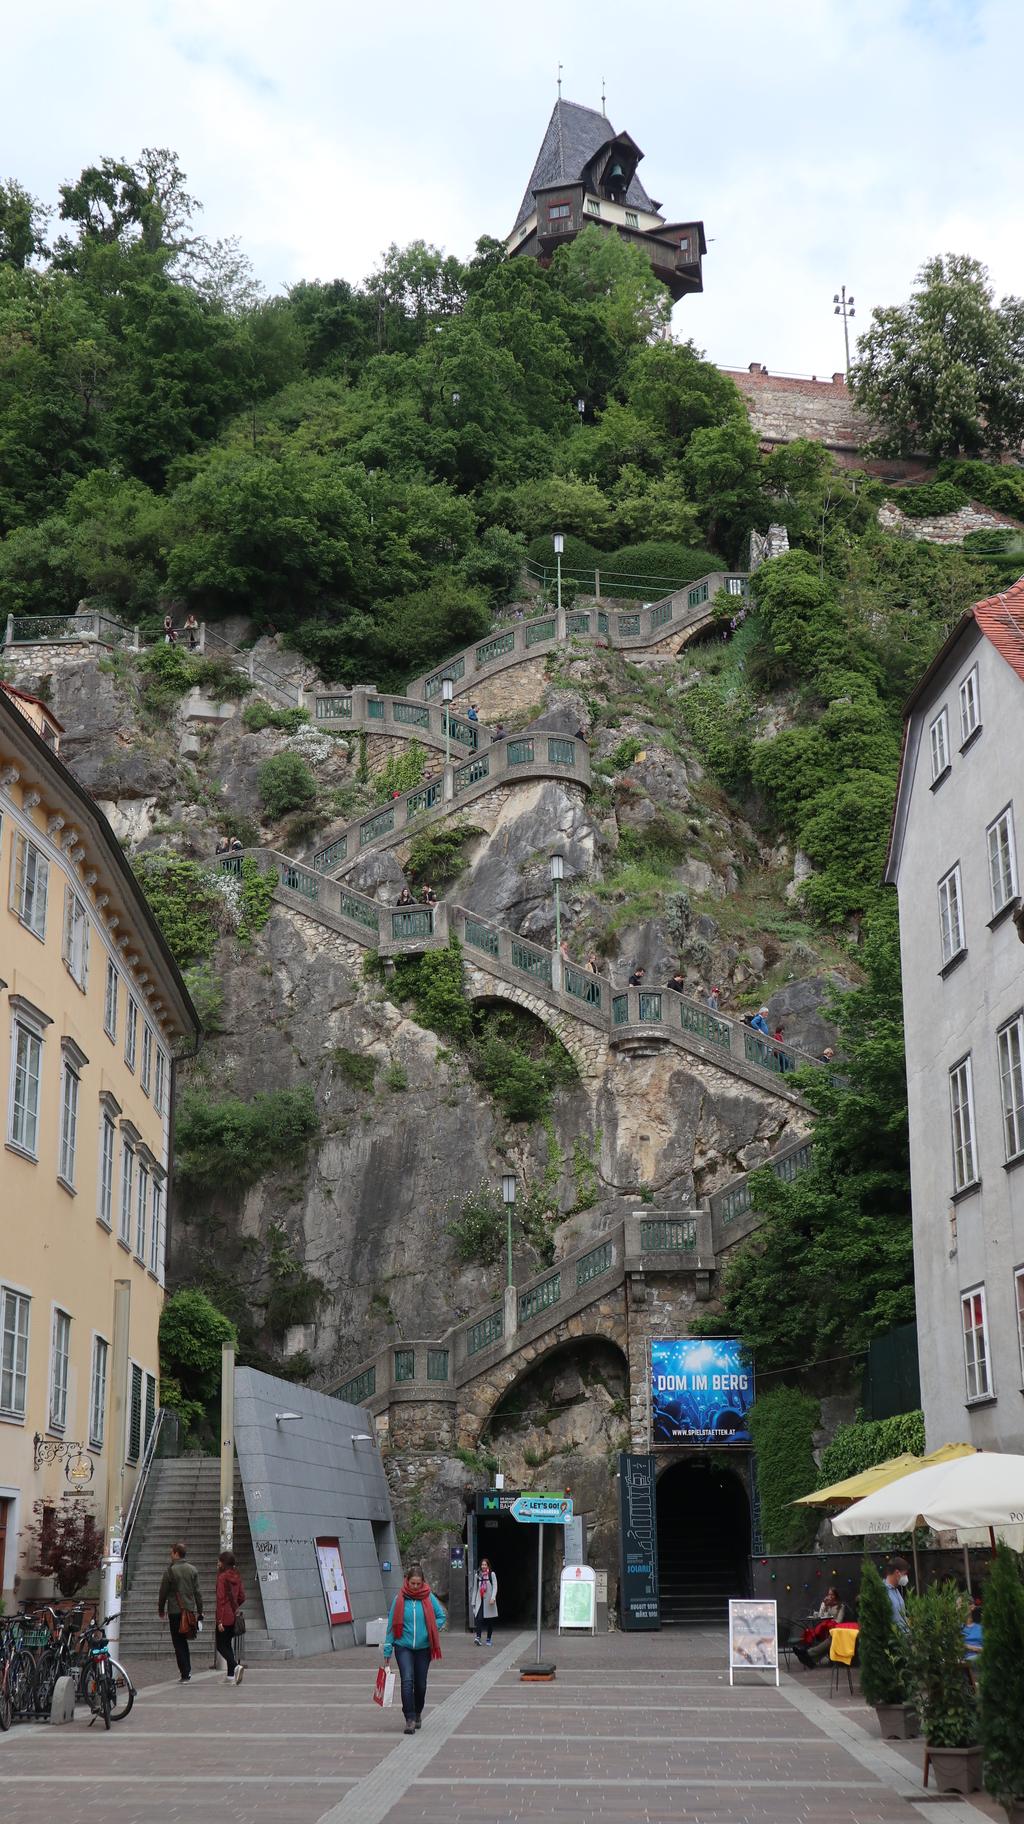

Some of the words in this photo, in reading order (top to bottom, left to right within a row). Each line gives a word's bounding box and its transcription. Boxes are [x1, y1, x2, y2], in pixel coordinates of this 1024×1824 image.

[658, 1375, 687, 1391] DOM
[692, 1375, 708, 1391] IM
[712, 1374, 748, 1390] BERG
[1008, 1511, 1024, 1522] PO
